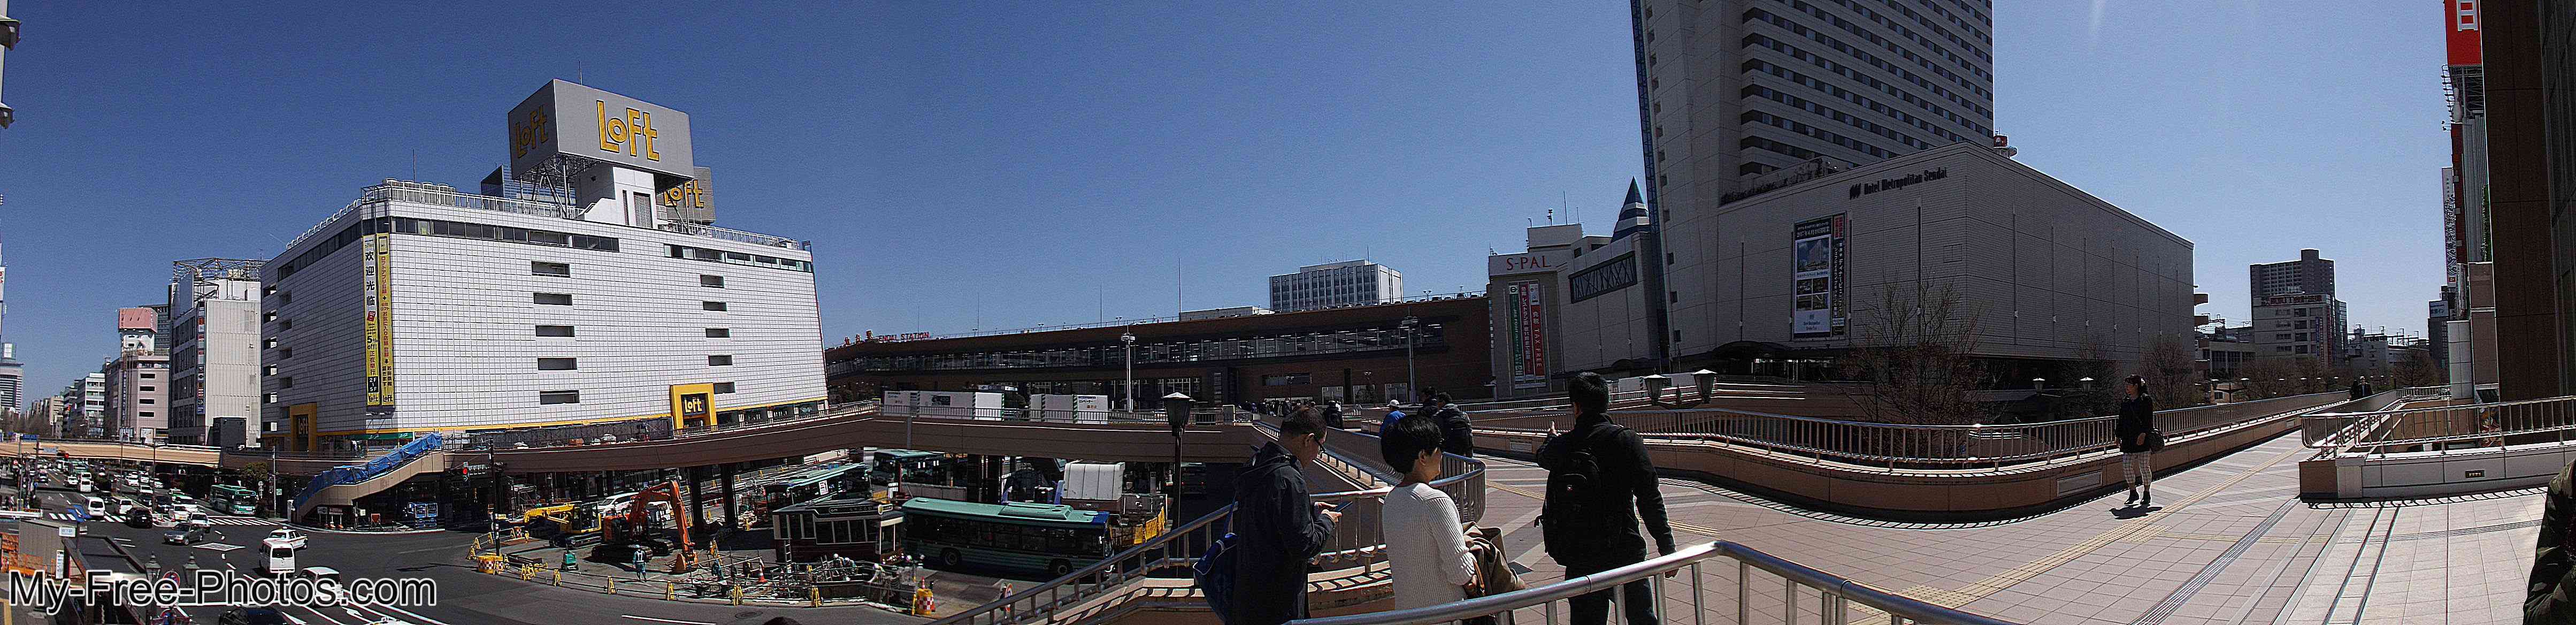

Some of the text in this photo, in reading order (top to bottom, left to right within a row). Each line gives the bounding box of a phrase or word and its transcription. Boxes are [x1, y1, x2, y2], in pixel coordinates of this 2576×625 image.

[1864, 166, 1948, 195] Hotel Metropolitan Sendai
[1506, 255, 1551, 271] S-PAL
[365, 251, 375, 306] 欢迎光临
[367, 336, 378, 344] 5%
[901, 332, 930, 340] STATION
